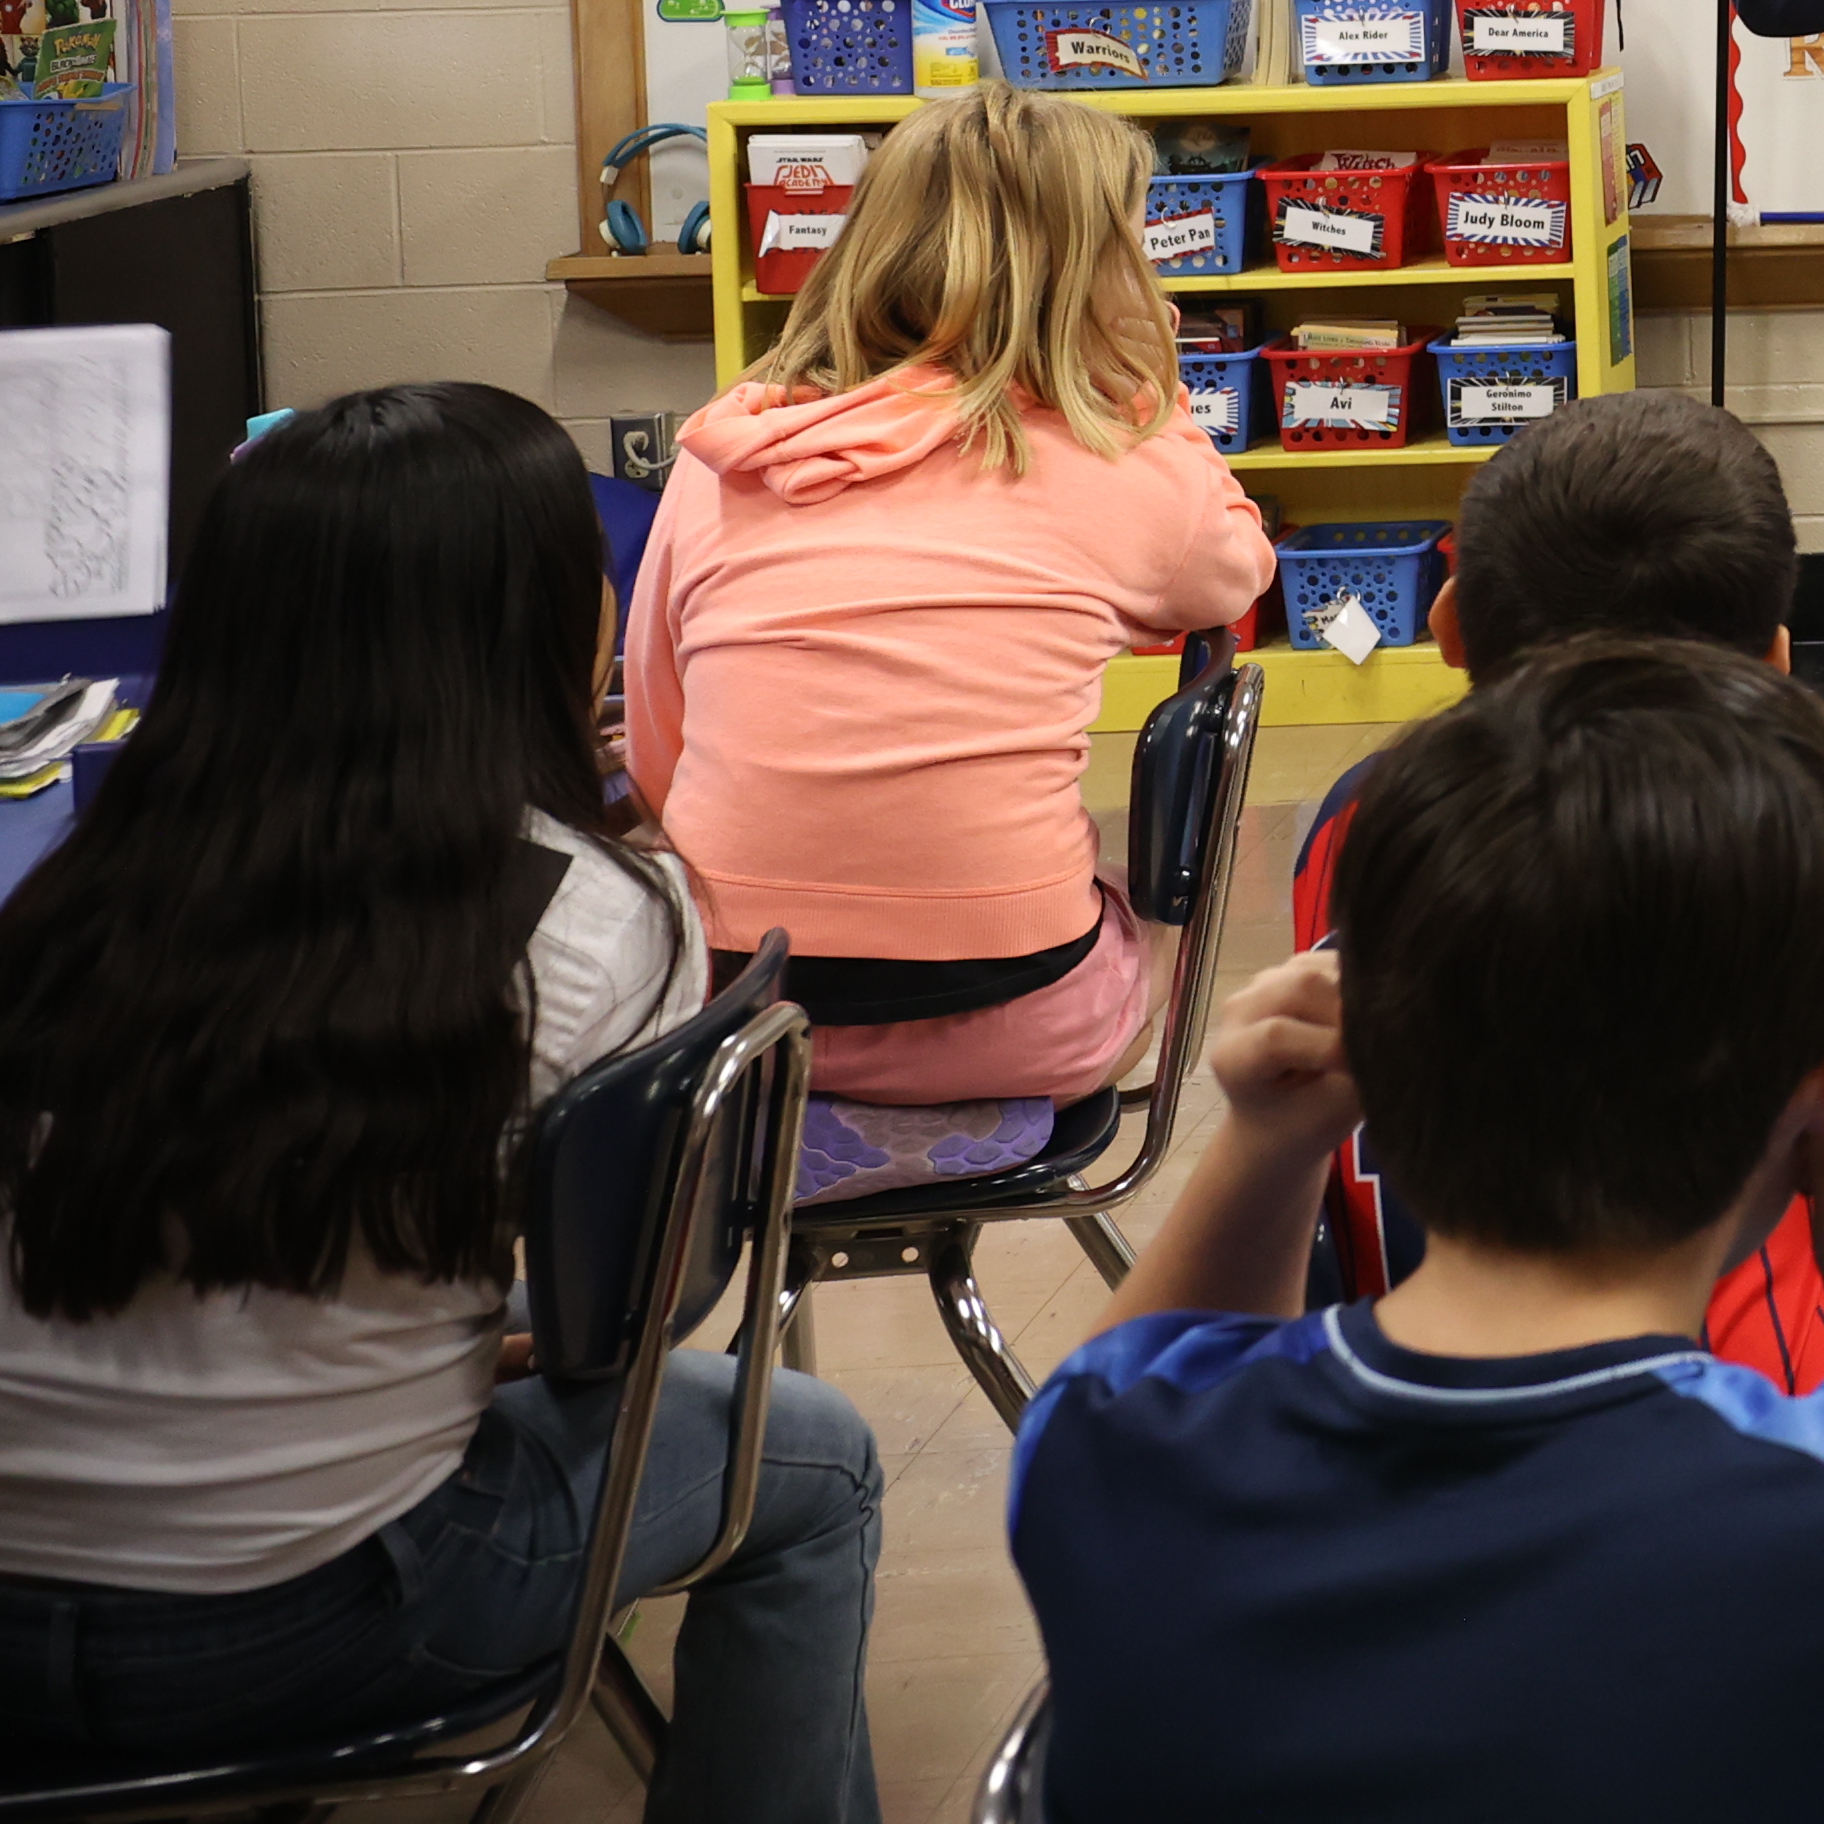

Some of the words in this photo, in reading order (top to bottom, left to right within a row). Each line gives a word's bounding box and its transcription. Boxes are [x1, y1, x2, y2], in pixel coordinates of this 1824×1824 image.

[1339, 30, 1361, 40] Alex
[1365, 29, 1388, 40] Rider
[1488, 27, 1510, 38] Dear
[1513, 28, 1549, 39] America
[1071, 40, 1130, 65] Warriors
[1312, 220, 1347, 236] Witches
[1463, 211, 1495, 230] Judy
[1500, 215, 1545, 231] Bloom
[789, 224, 827, 237] Fantasy
[1150, 233, 1183, 252] Peter
[1186, 226, 1211, 244] Pan
[1486, 389, 1532, 399] Geronimo
[1330, 396, 1352, 411] Avi
[1491, 401, 1524, 412] Stilton
